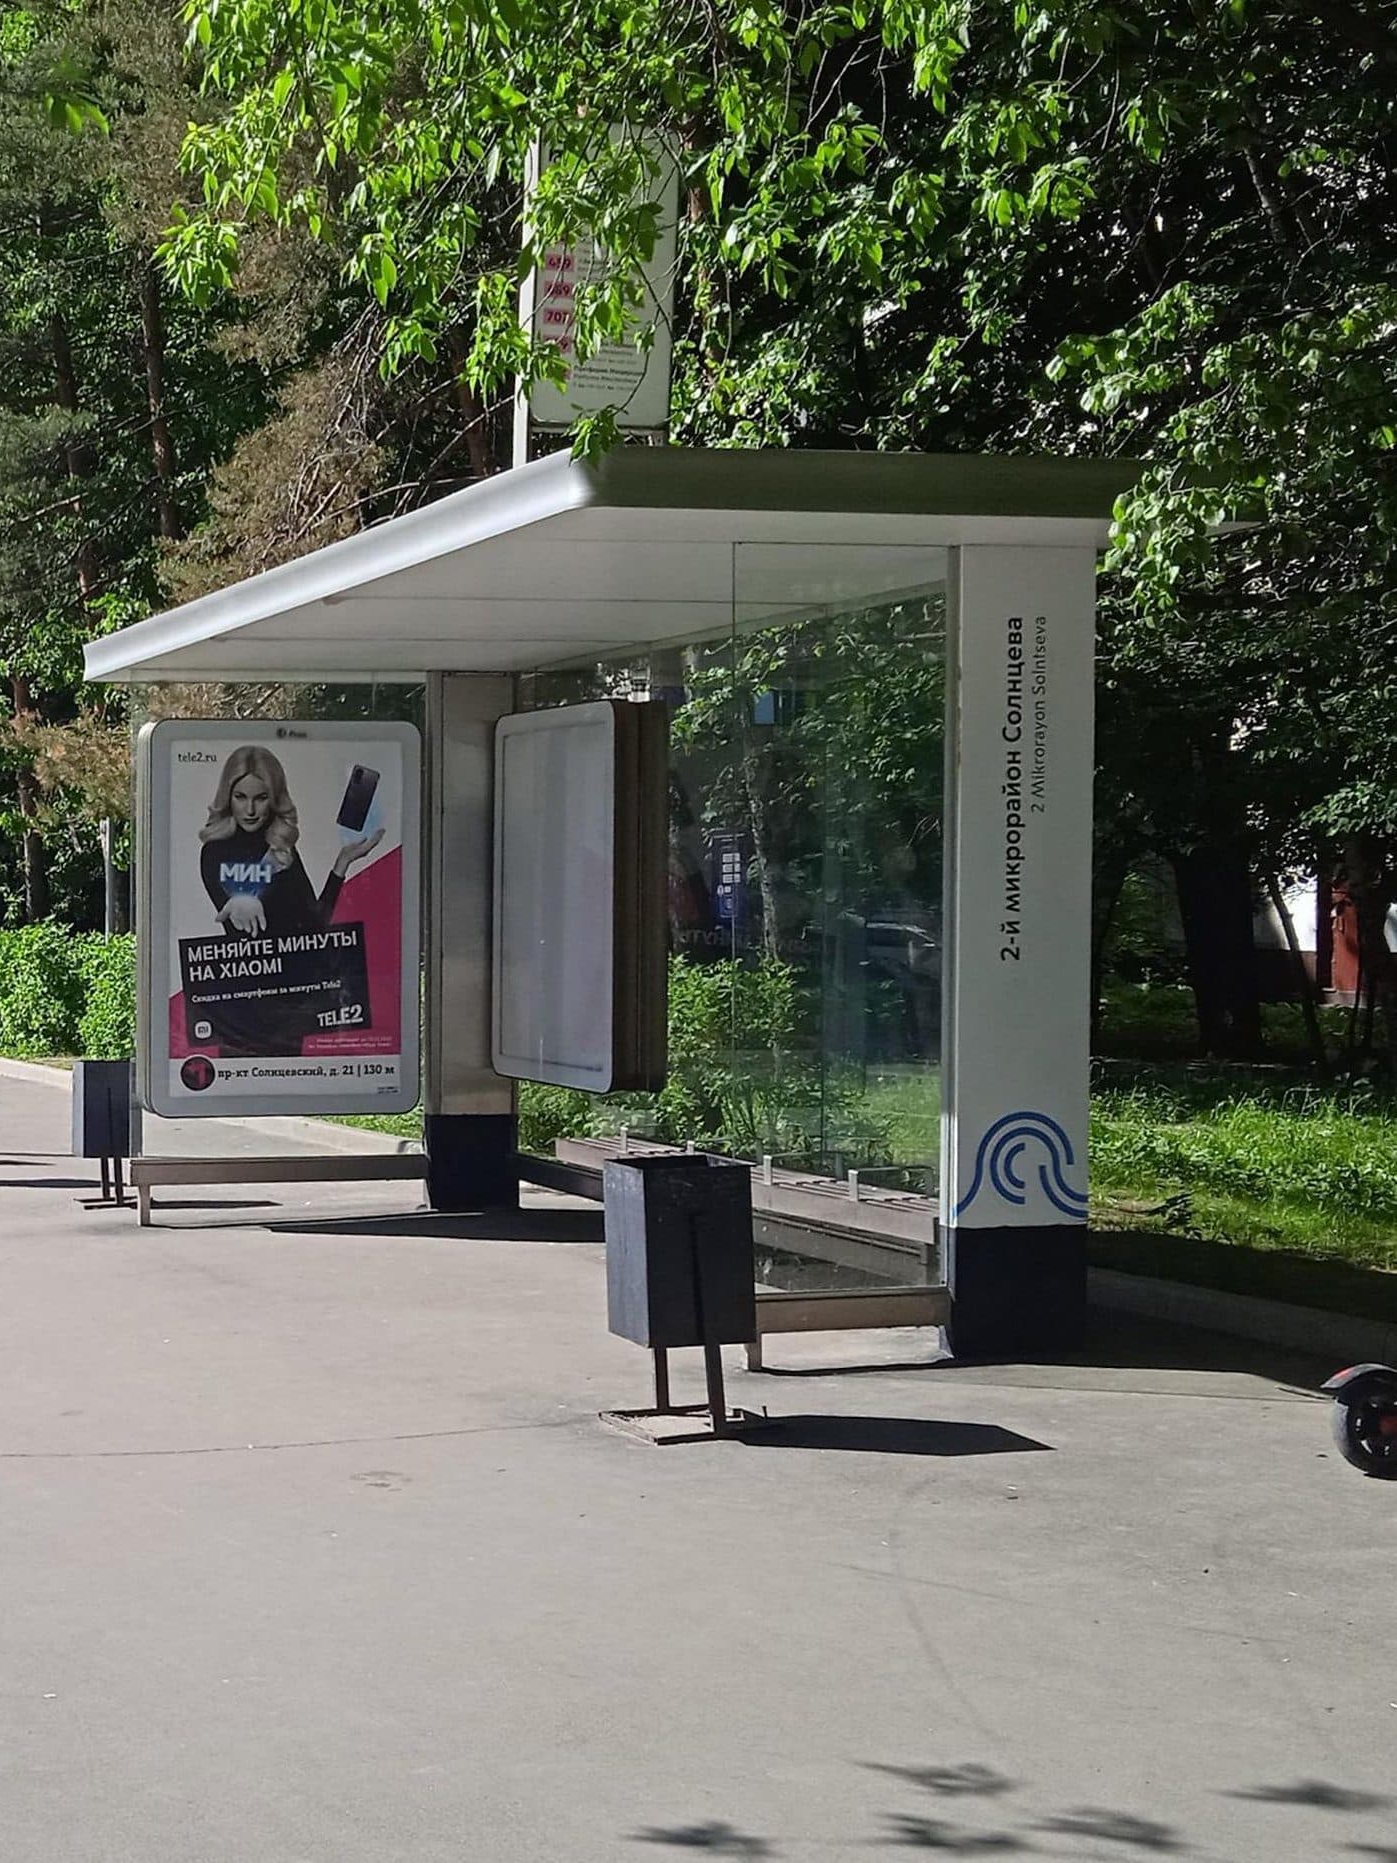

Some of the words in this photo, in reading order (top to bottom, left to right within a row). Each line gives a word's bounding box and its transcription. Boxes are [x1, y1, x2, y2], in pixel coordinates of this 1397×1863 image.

[1032, 616, 1046, 695] Solntseva
[1002, 617, 1025, 743] Солнцева
[178, 752, 217, 762] tele2.ru
[1031, 700, 1049, 798] Mikrorayon
[1032, 803, 1044, 813] 2
[1002, 751, 1025, 913] микрорайон
[220, 863, 271, 883] МИН
[188, 938, 273, 962] МЕНЯЙТЕ
[278, 931, 357, 953] МИНУТЫ
[1001, 922, 1020, 961] 2-й
[189, 965, 215, 982] НА
[219, 958, 282, 979] XIAOMI
[317, 1004, 363, 1026] TELE2
[218, 1068, 249, 1080] пр-кт
[251, 1066, 327, 1079] Солнцевский,
[342, 1065, 354, 1076] 21
[364, 1064, 382, 1075] 130
